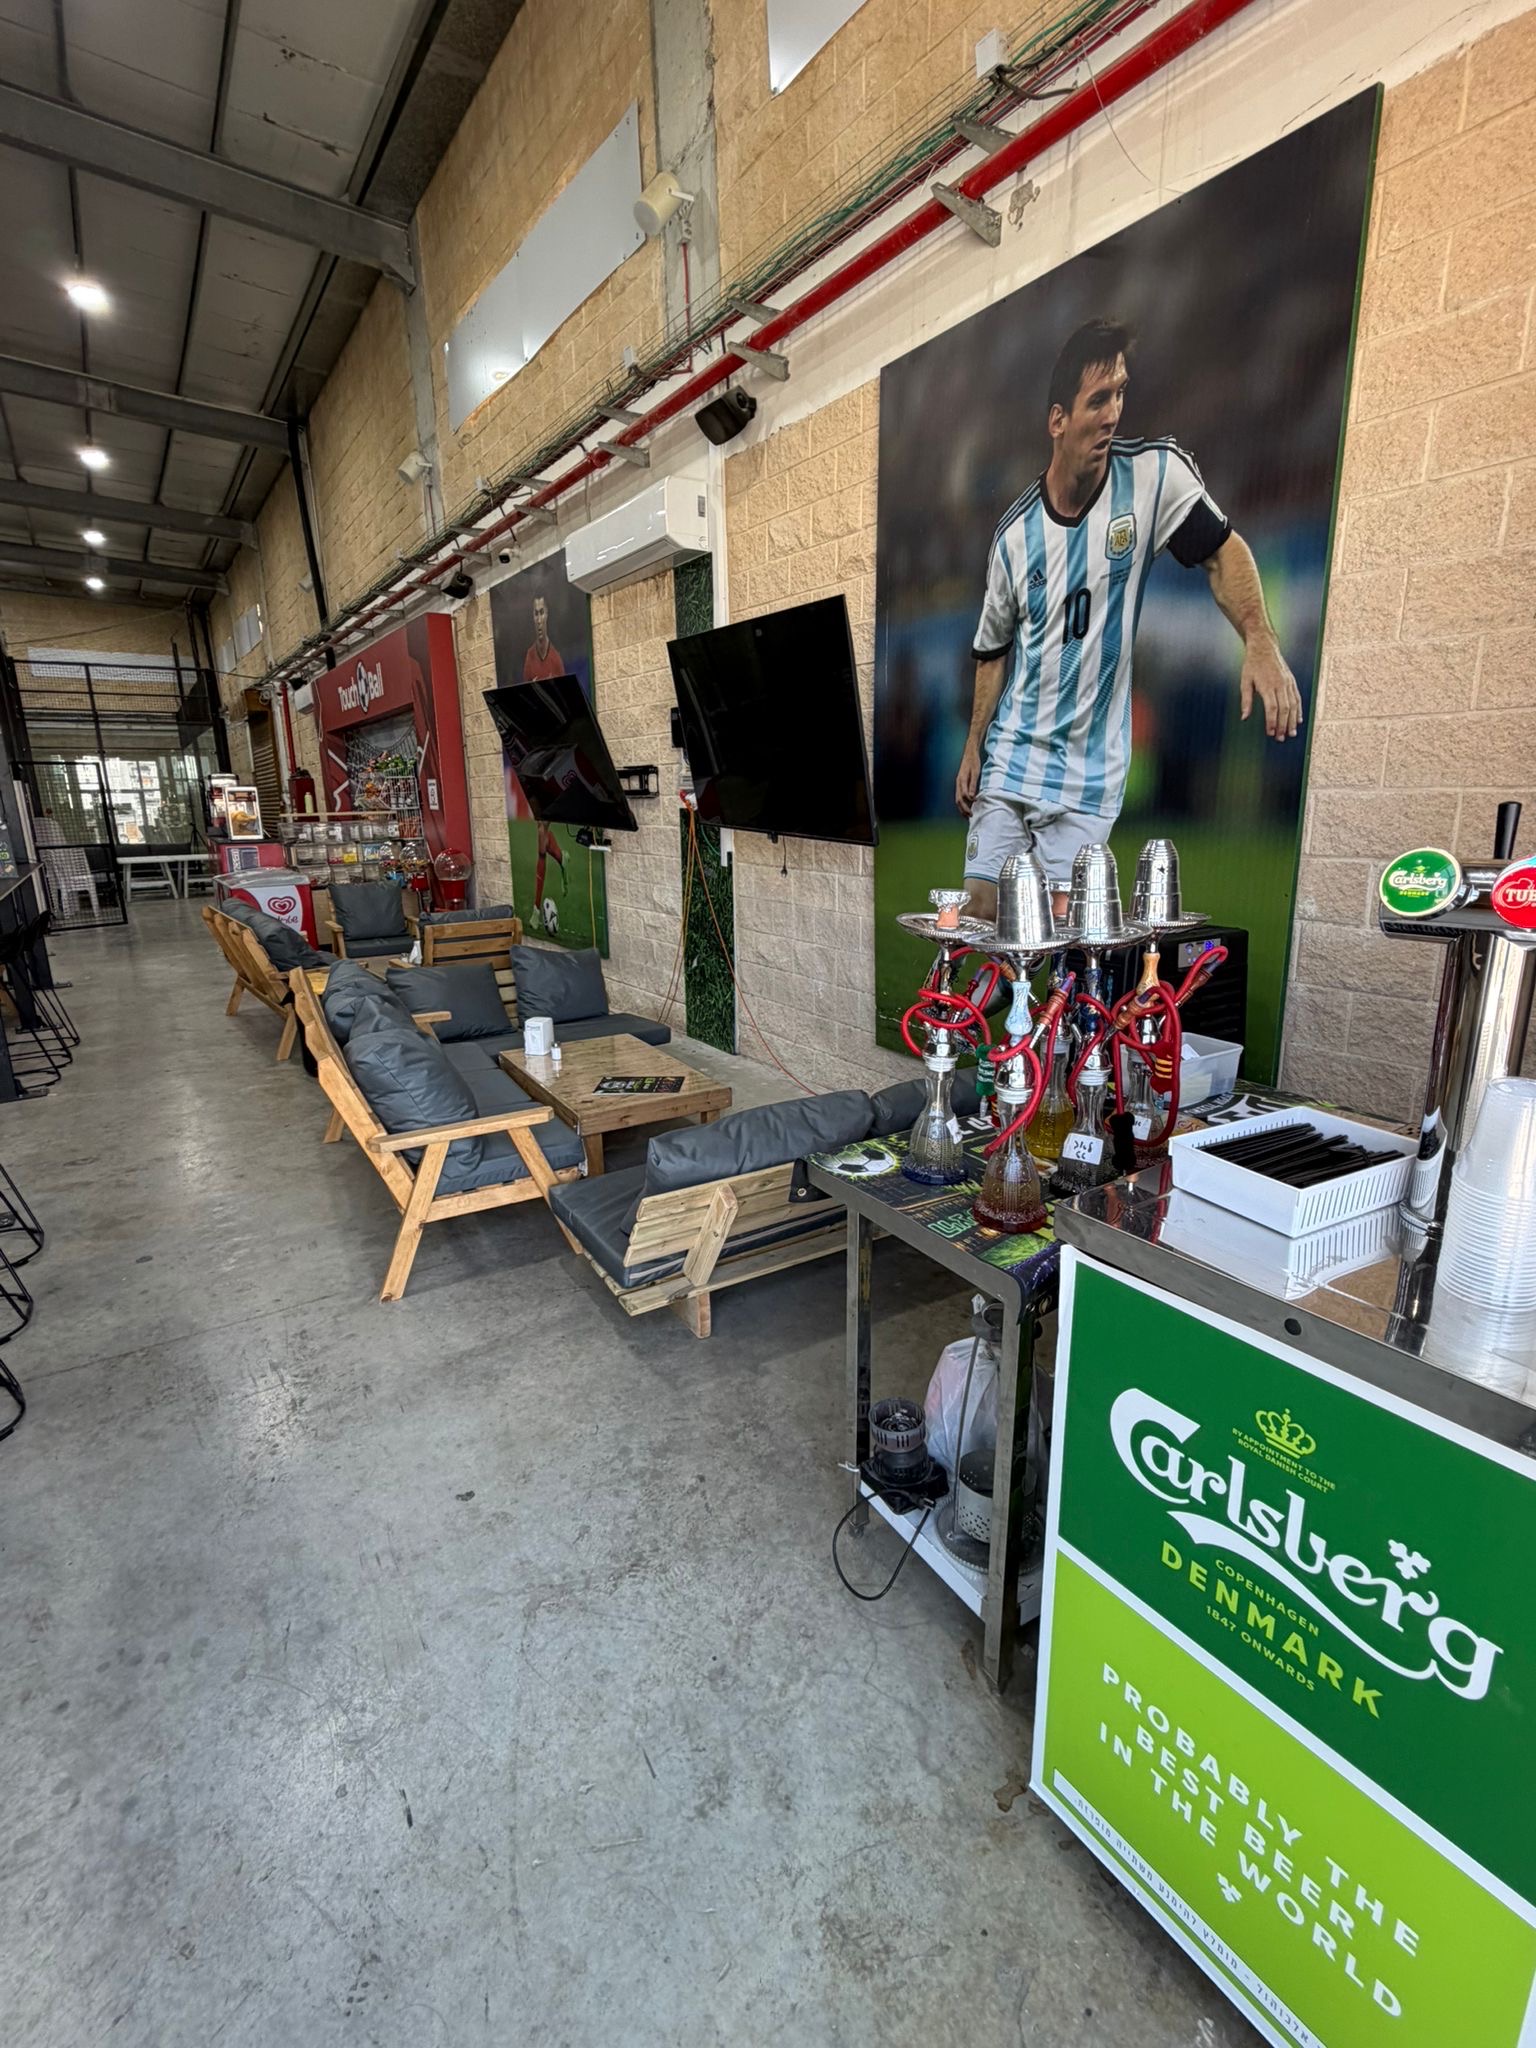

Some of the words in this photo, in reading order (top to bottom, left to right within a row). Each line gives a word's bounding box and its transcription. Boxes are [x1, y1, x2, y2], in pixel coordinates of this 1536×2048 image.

[1062, 588, 1092, 645] 10
[337, 676, 360, 713] Touch
[367, 661, 385, 700] Ball
[1389, 870, 1448, 889] Carlsberg
[1238, 1438, 1264, 1457] ROYAL
[1265, 1454, 1296, 1476] DANISH
[1297, 1472, 1328, 1493] COURT
[1243, 1434, 1303, 1471] APPOINTMENT
[1304, 1468, 1317, 1480] TO
[1318, 1475, 1336, 1490] THE
[1110, 1388, 1504, 1700] Carlsberg
[1215, 1559, 1320, 1637] COPENHAGEN
[1161, 1540, 1384, 1719] DENMARK
[1206, 1605, 1237, 1632] 1847
[1240, 1631, 1315, 1692] ONWARDS
[1102, 1662, 1303, 1848] PROBABLY
[1325, 1855, 1420, 1958] THE
[1136, 1724, 1224, 1815] BEST
[1243, 1822, 1355, 1940] BEER
[1099, 1721, 1133, 1768] IN
[1150, 1767, 1217, 1848] THE
[1238, 1849, 1402, 2017] WORLD
[1116, 1838, 1153, 1881] משתייה
[1158, 1882, 1197, 1925] להימנע
[1203, 1927, 1238, 1970] מומלץ
[1257, 1983, 1309, 2043] אלכוהול
